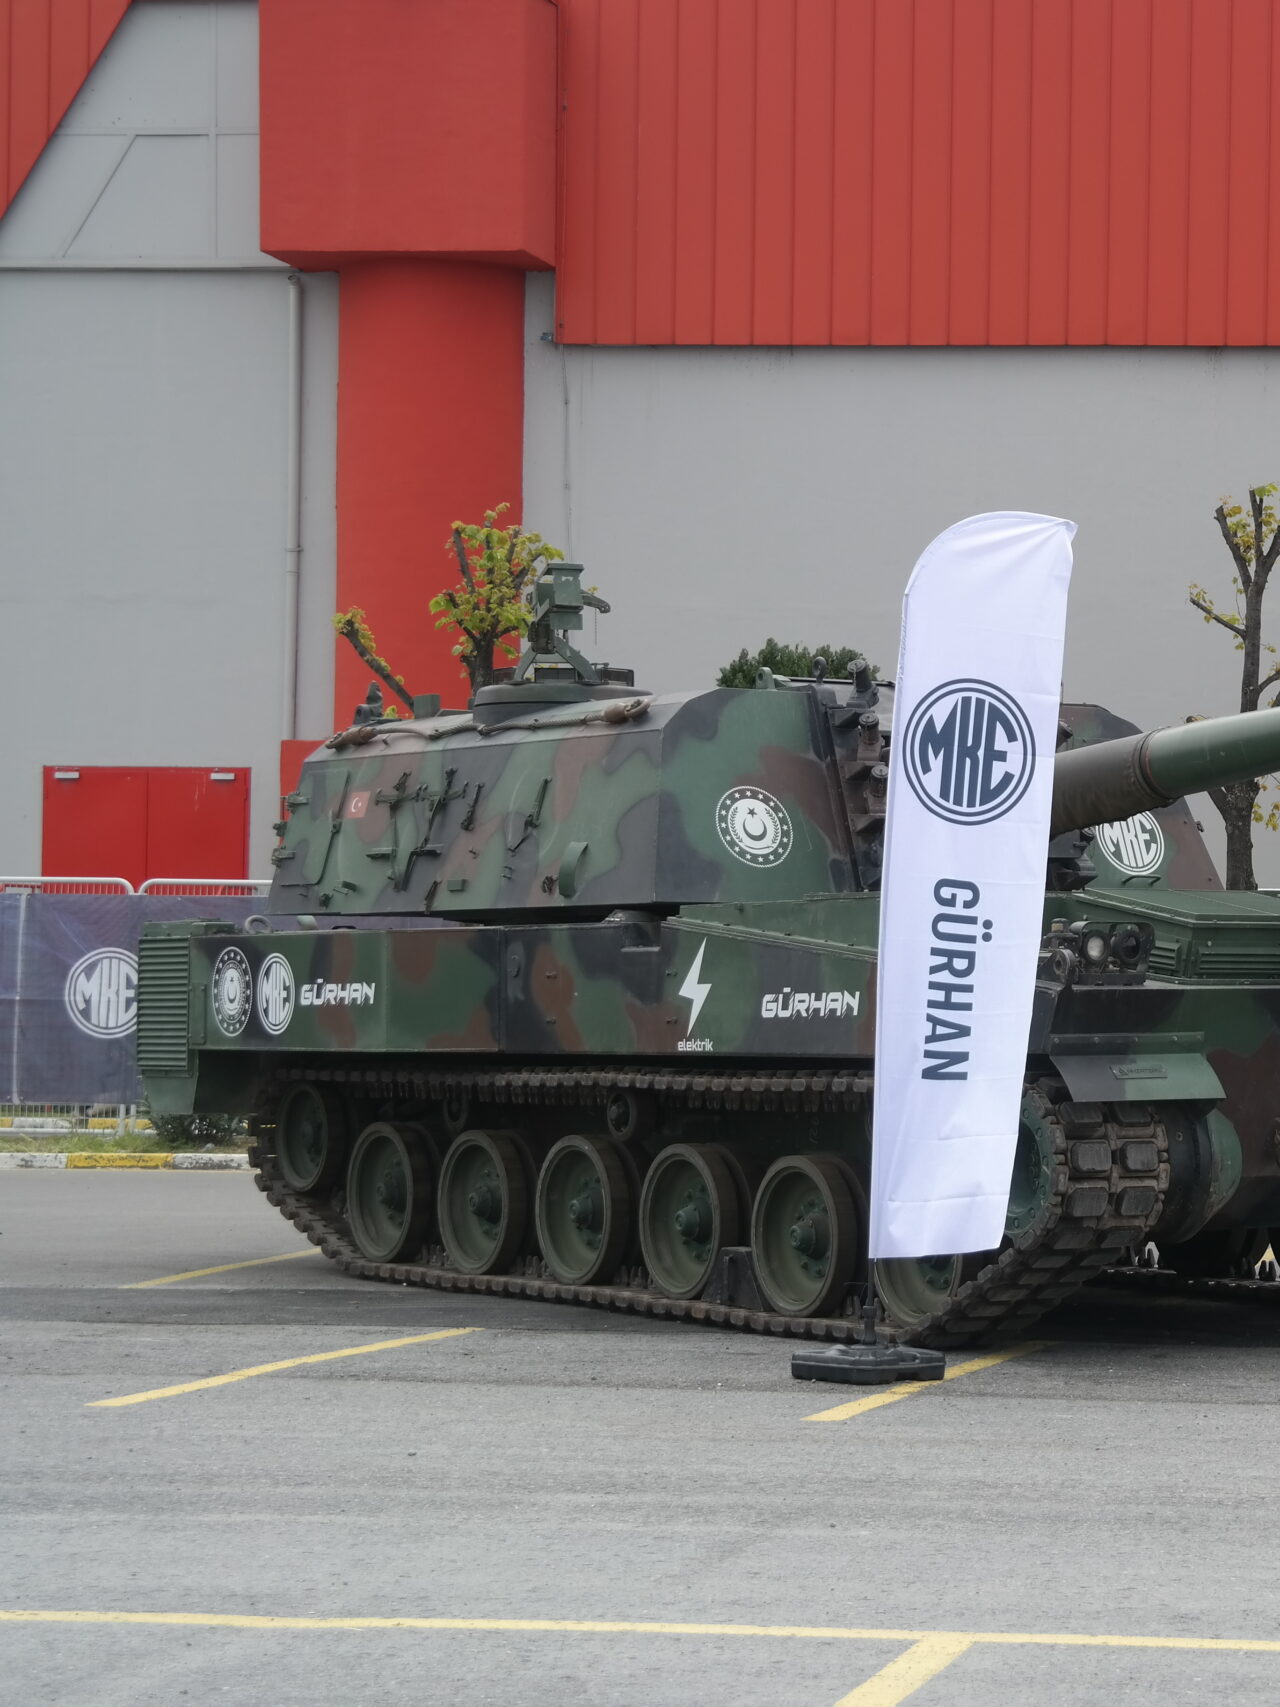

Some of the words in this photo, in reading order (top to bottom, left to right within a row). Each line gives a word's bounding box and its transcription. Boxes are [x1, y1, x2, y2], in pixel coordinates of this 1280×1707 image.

[919, 696, 1018, 808] MKE
[1103, 812, 1158, 868] MKE
[262, 962, 290, 1025] MKE
[921, 877, 994, 1081] GÜRHAN
[677, 1038, 713, 1052] elektrik
